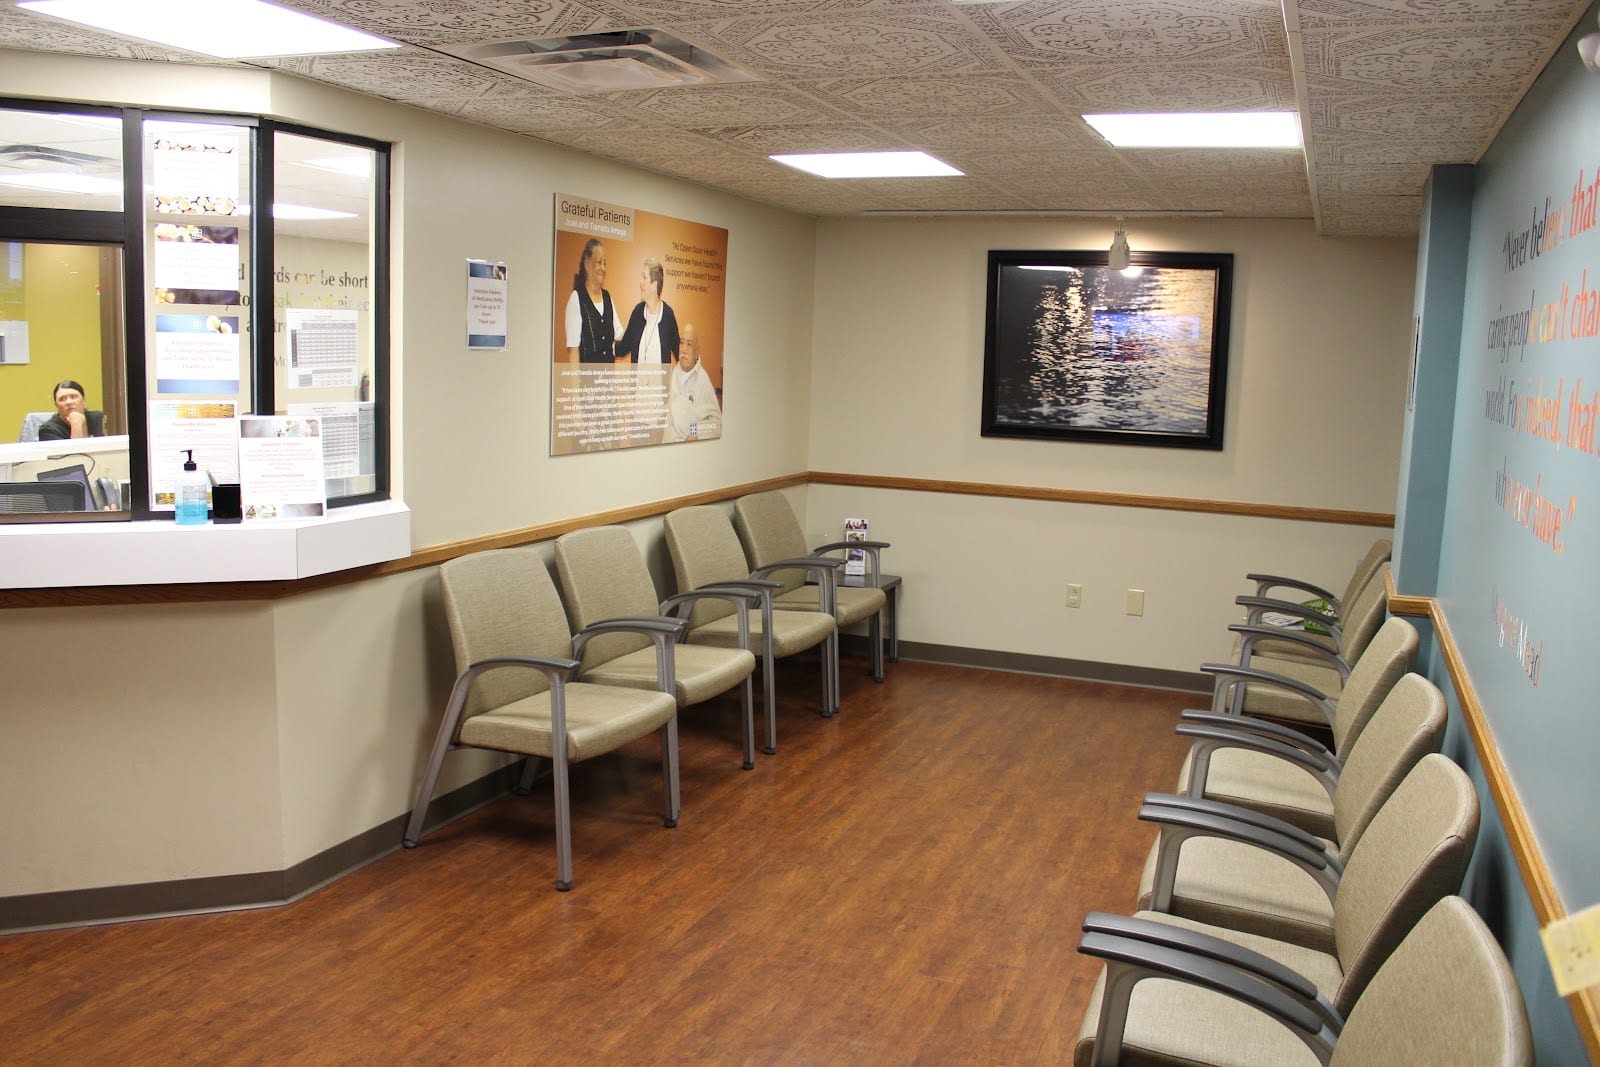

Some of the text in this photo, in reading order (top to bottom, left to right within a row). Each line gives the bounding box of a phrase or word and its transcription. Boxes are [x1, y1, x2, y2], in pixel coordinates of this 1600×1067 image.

[561, 200, 631, 226] Grateful Patients
[1570, 165, 1600, 239] that
[338, 271, 368, 289] short
[1570, 268, 1600, 340] cha
